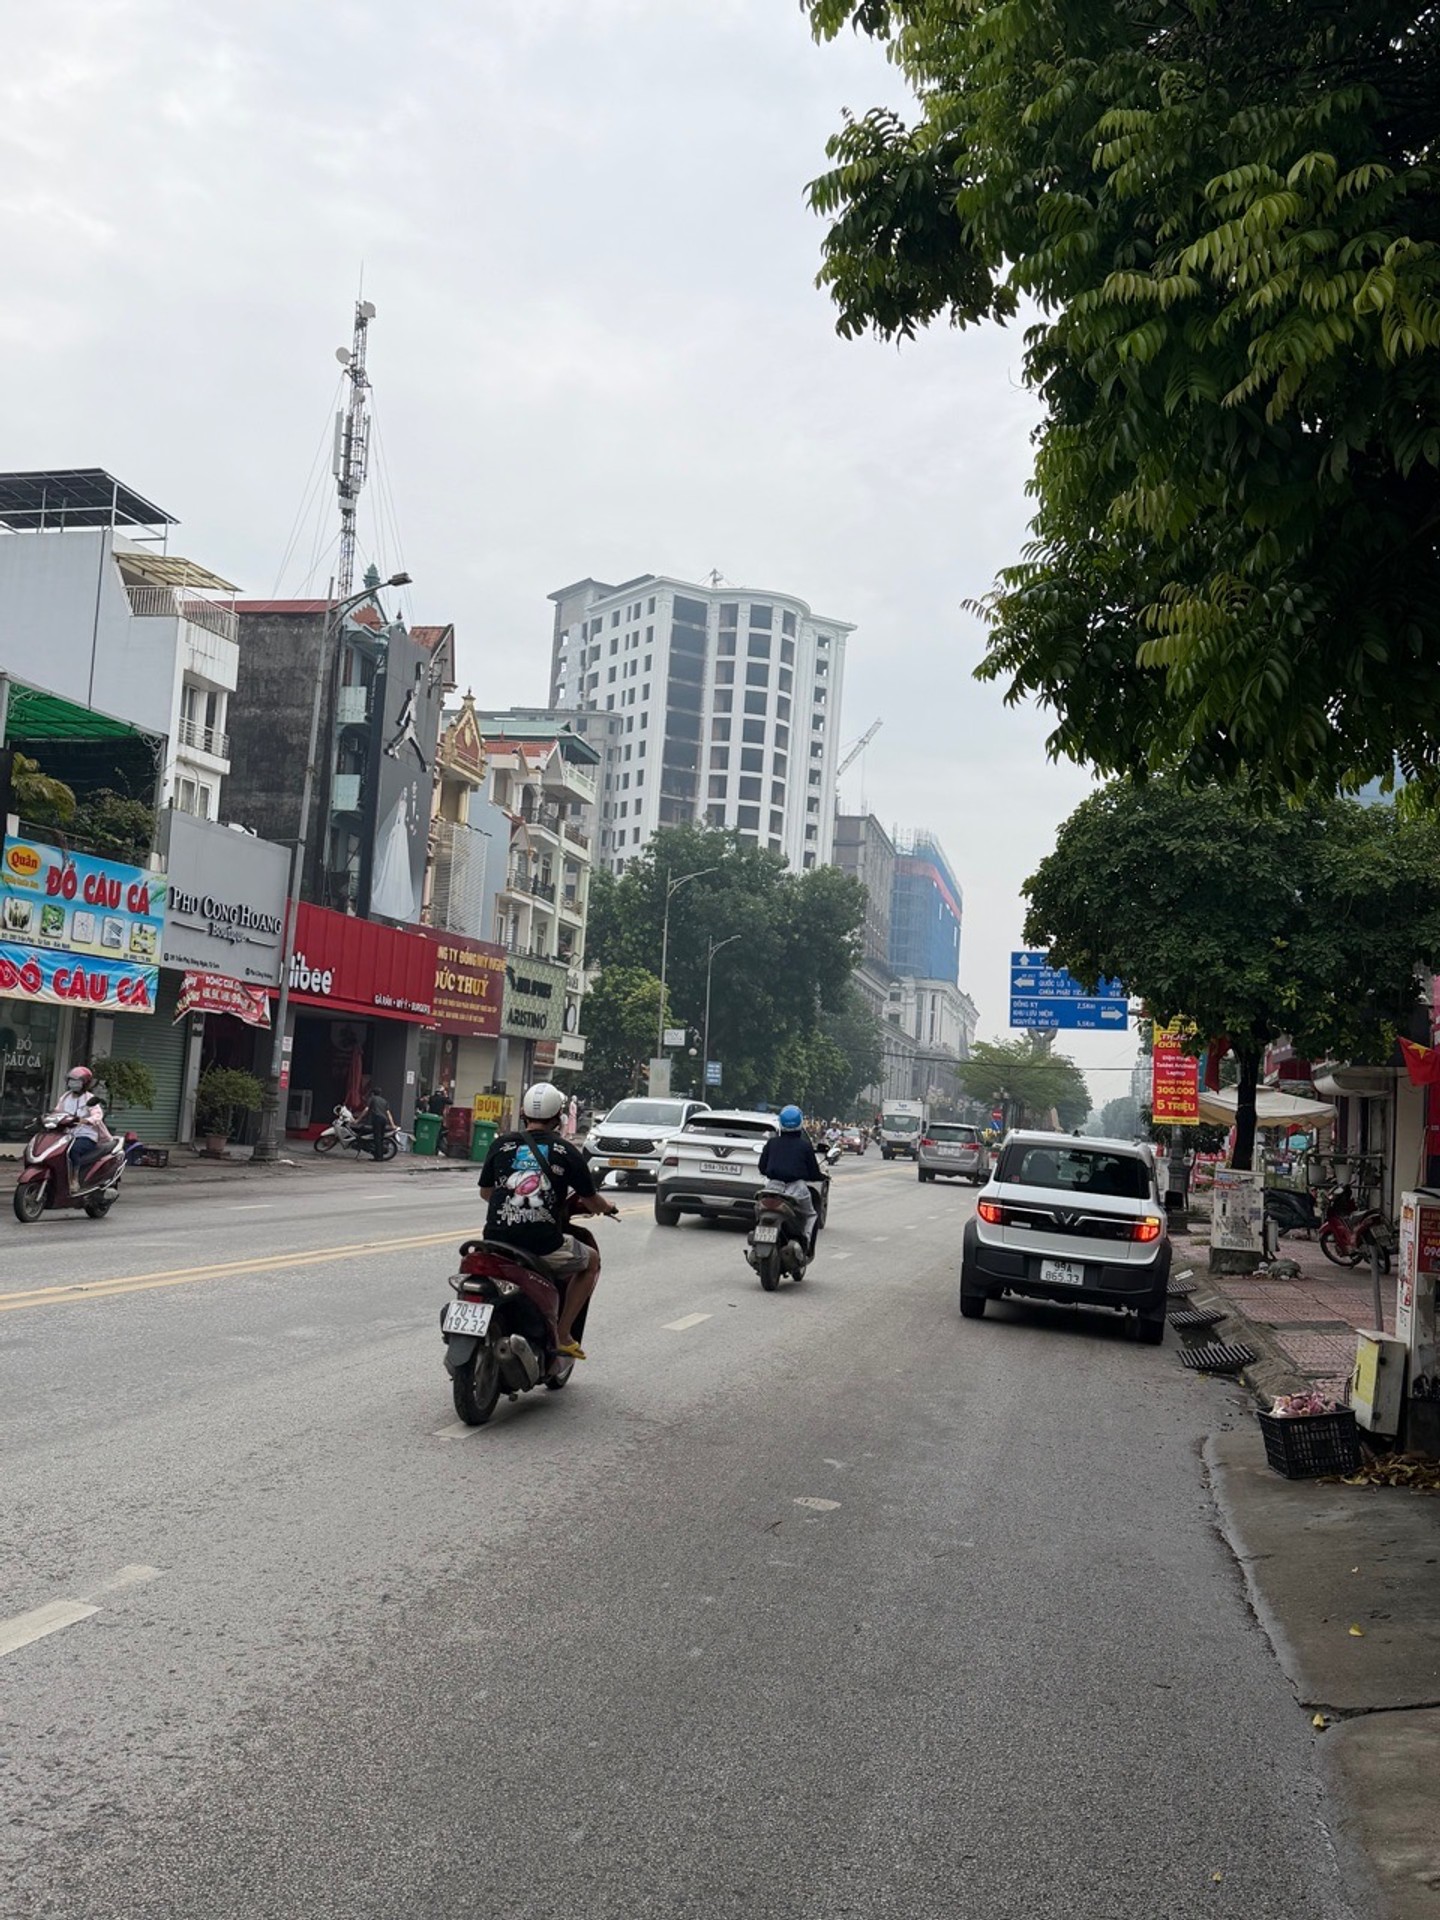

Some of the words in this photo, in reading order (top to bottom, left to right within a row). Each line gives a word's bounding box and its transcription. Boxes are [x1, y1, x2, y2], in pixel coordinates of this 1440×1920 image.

[83, 872, 122, 910] CÂU
[127, 881, 150, 915] CÁ
[52, 964, 109, 1004] CÂU
[117, 974, 150, 1008] CÁ
[1157, 1086, 1195, 1096] 300.000
[477, 1097, 499, 1114] BÚN
[1156, 1099, 1165, 1110] 5
[1168, 1100, 1196, 1113] TRIỆU
